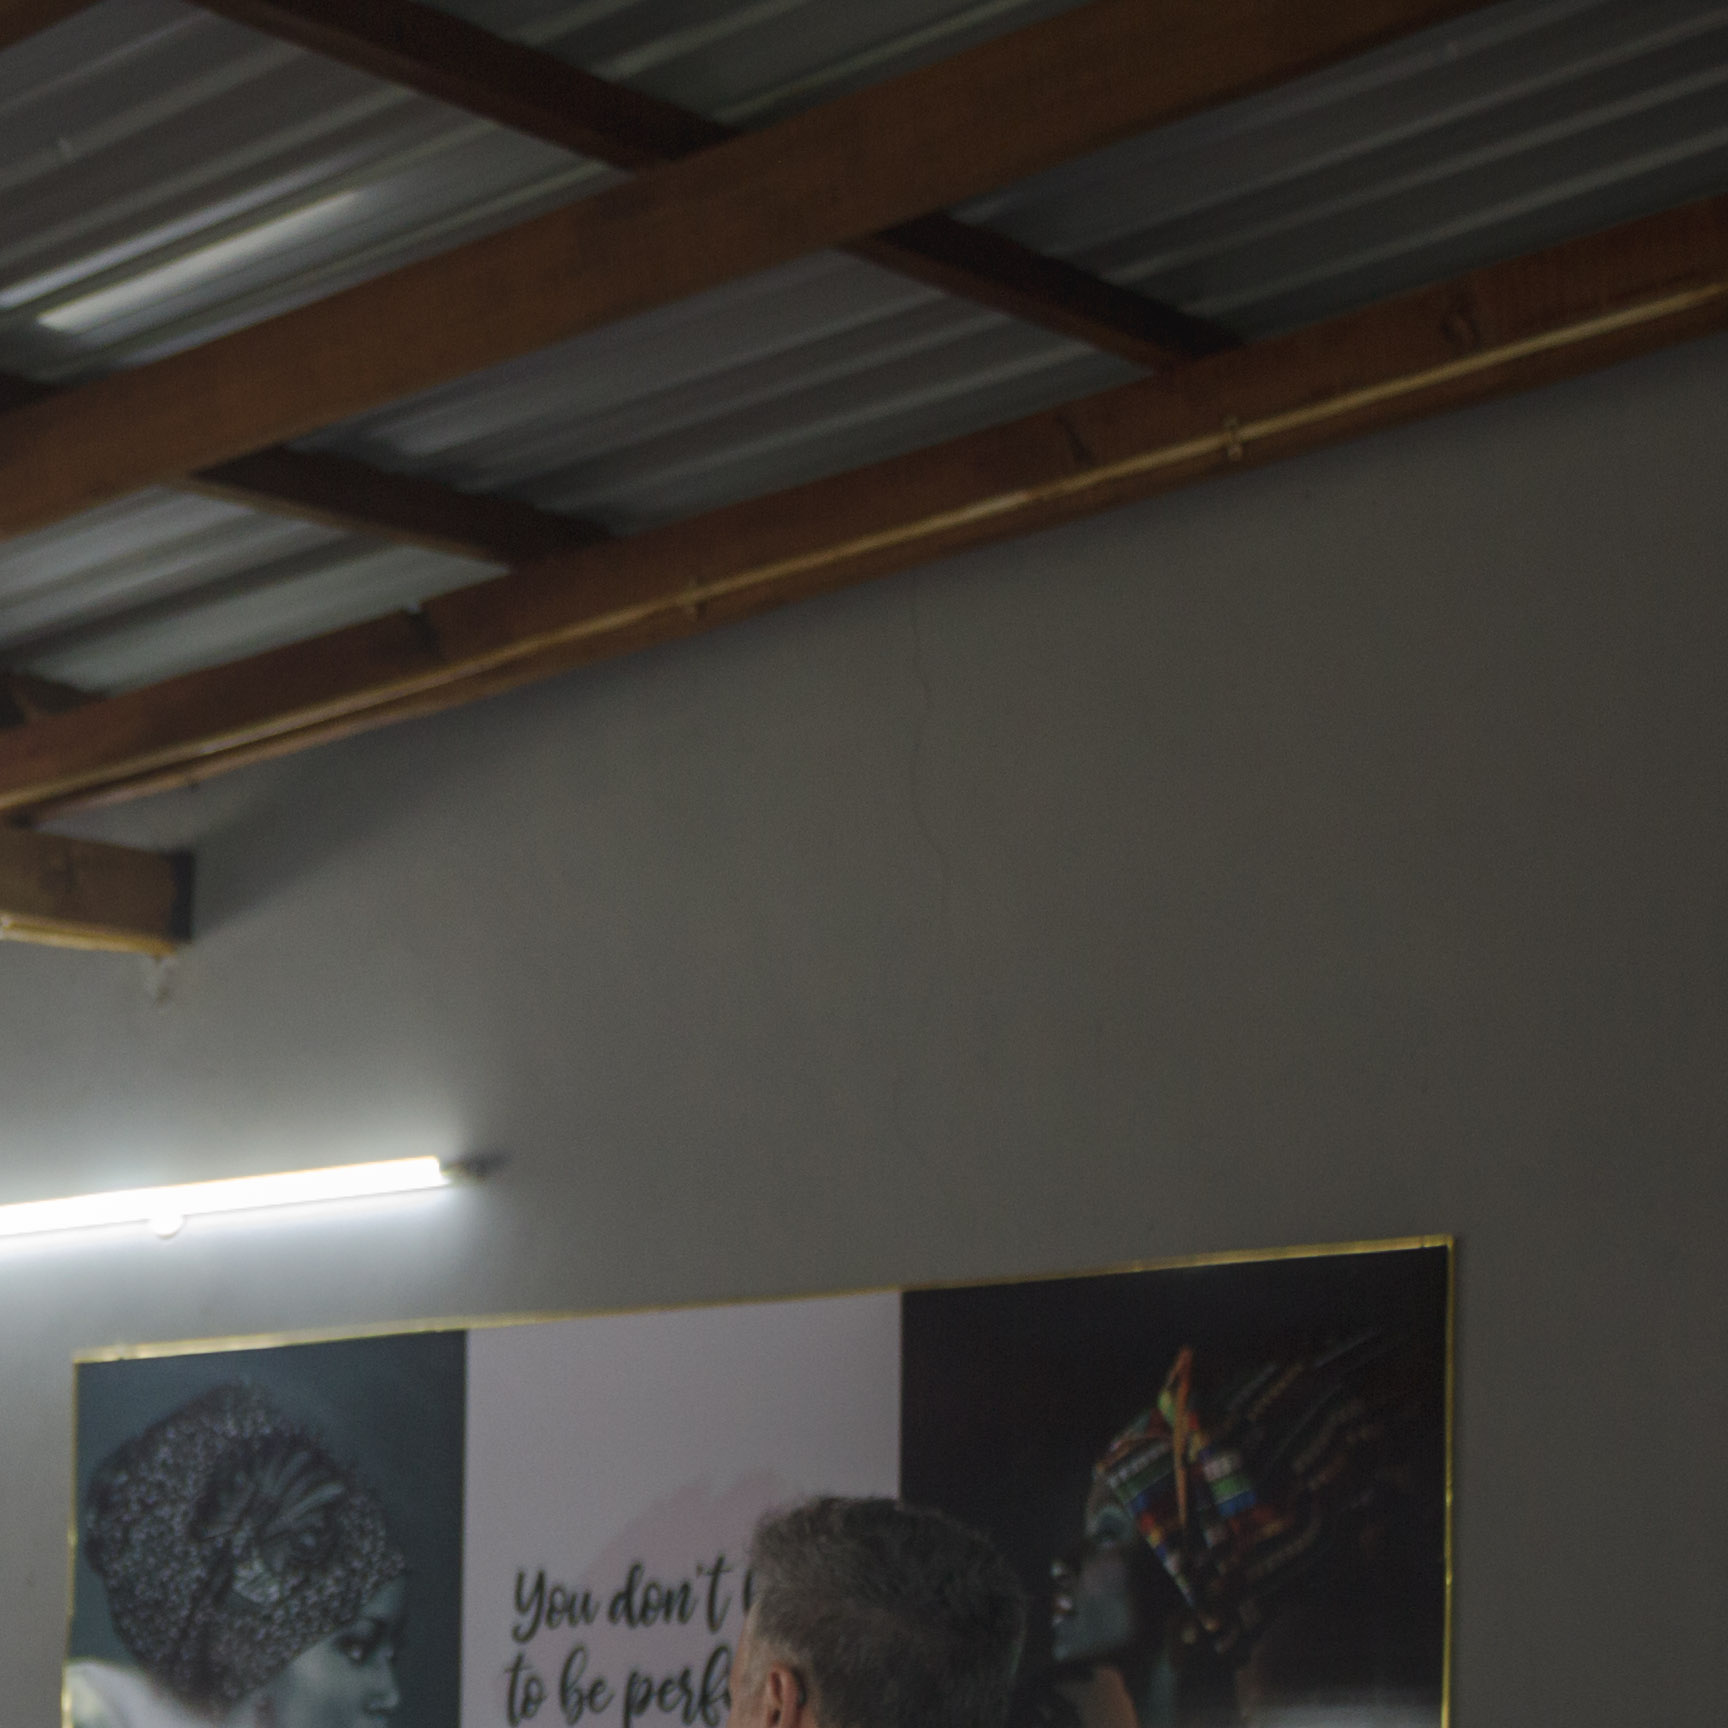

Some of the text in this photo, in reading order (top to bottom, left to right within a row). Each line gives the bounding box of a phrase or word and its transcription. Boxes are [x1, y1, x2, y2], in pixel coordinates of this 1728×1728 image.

[512, 1567, 598, 1644] You
[608, 1554, 732, 1634] don't
[559, 1643, 615, 1727] be
